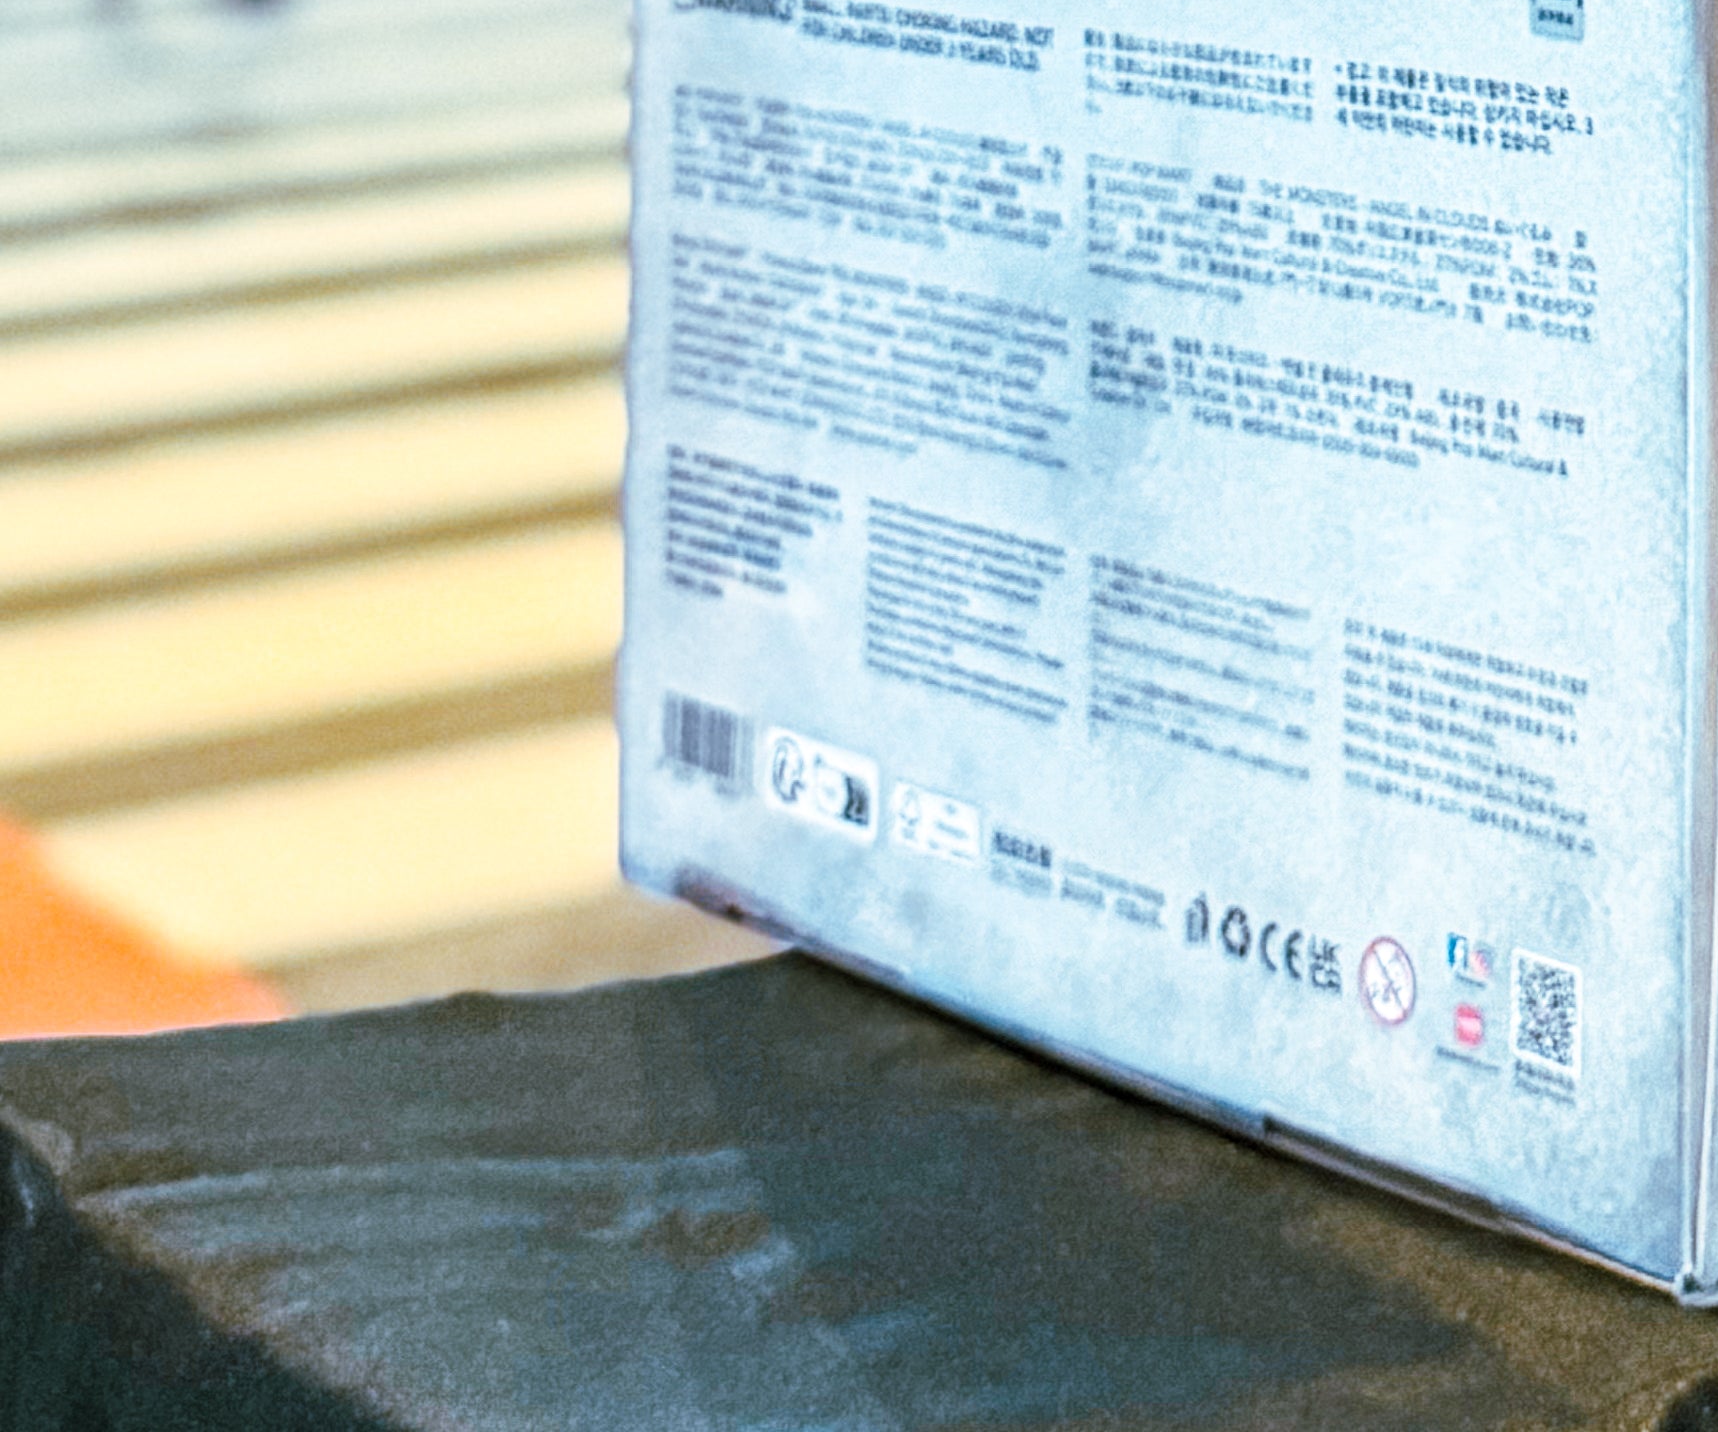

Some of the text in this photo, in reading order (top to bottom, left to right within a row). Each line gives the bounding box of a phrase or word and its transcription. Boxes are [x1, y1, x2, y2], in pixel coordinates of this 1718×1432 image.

[900, 34, 943, 57] UNDER
[959, 39, 1006, 67] YEARS
[1023, 26, 1055, 49] NOT
